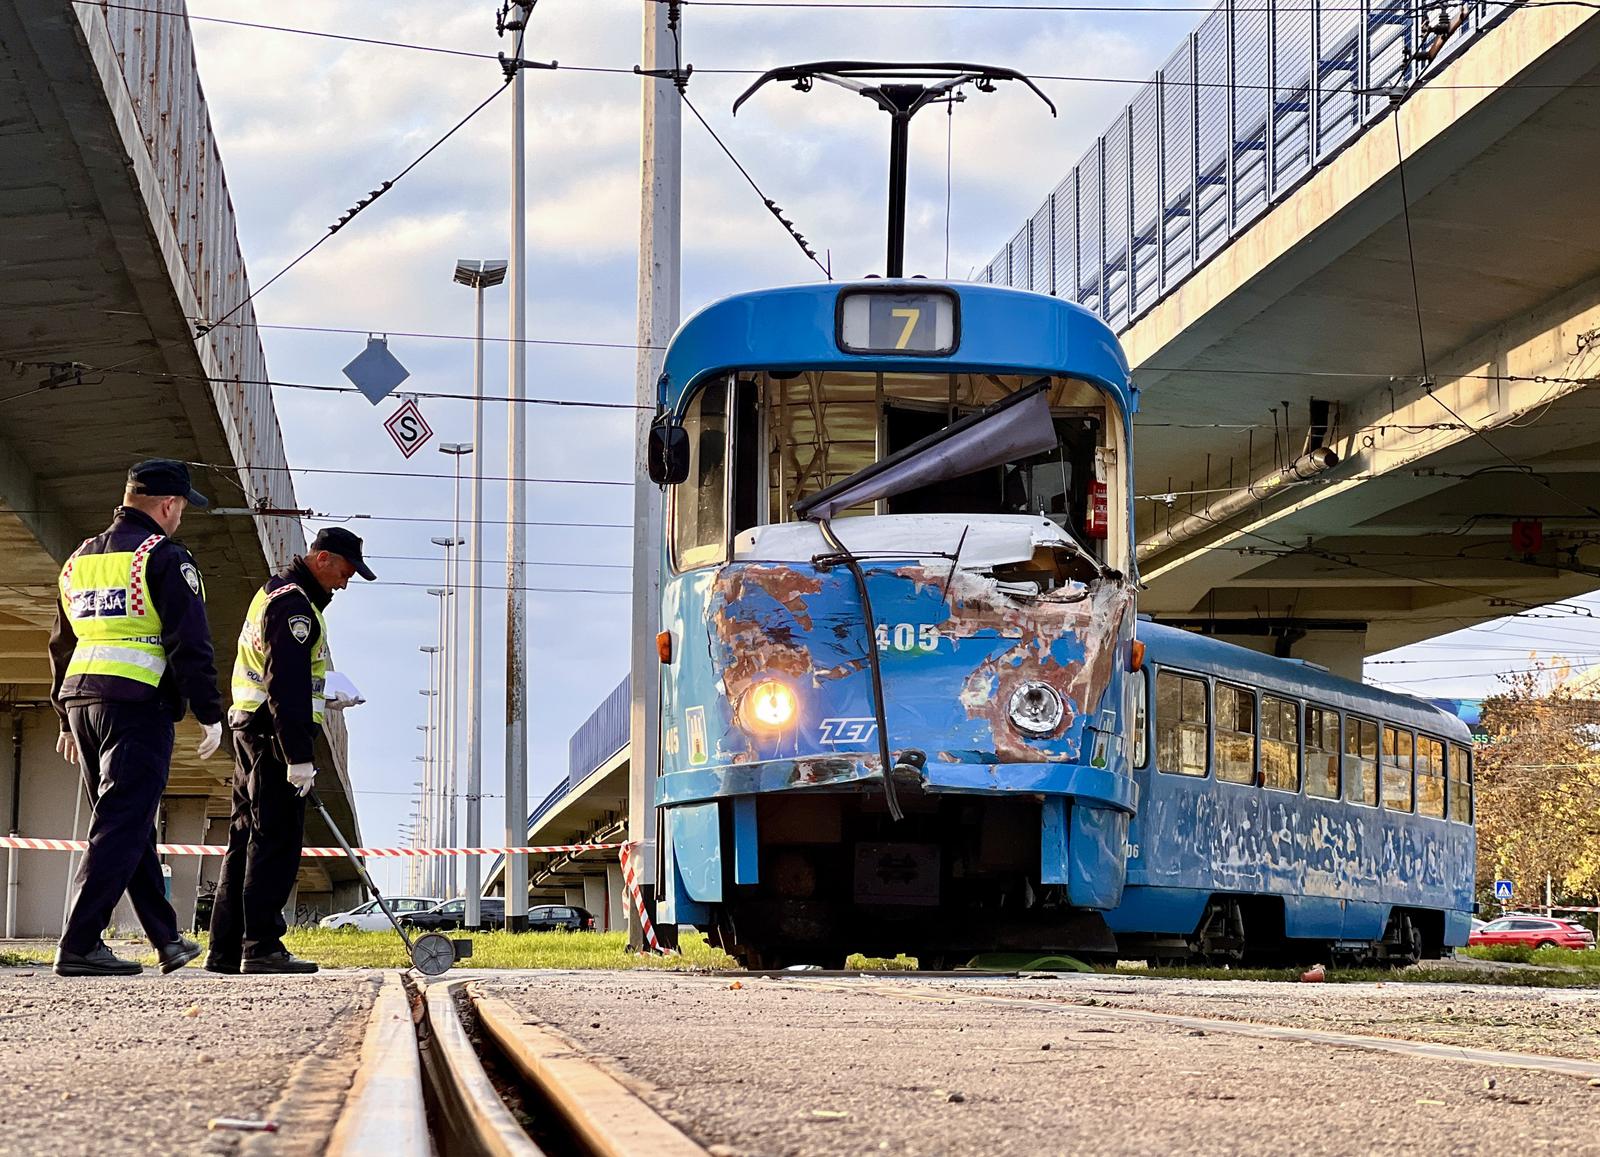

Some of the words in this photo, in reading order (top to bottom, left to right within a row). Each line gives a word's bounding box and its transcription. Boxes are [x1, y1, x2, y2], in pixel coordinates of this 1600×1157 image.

[892, 308, 920, 349] 7
[400, 416, 418, 442] S
[1520, 525, 1535, 548] S
[874, 623, 939, 652] 405
